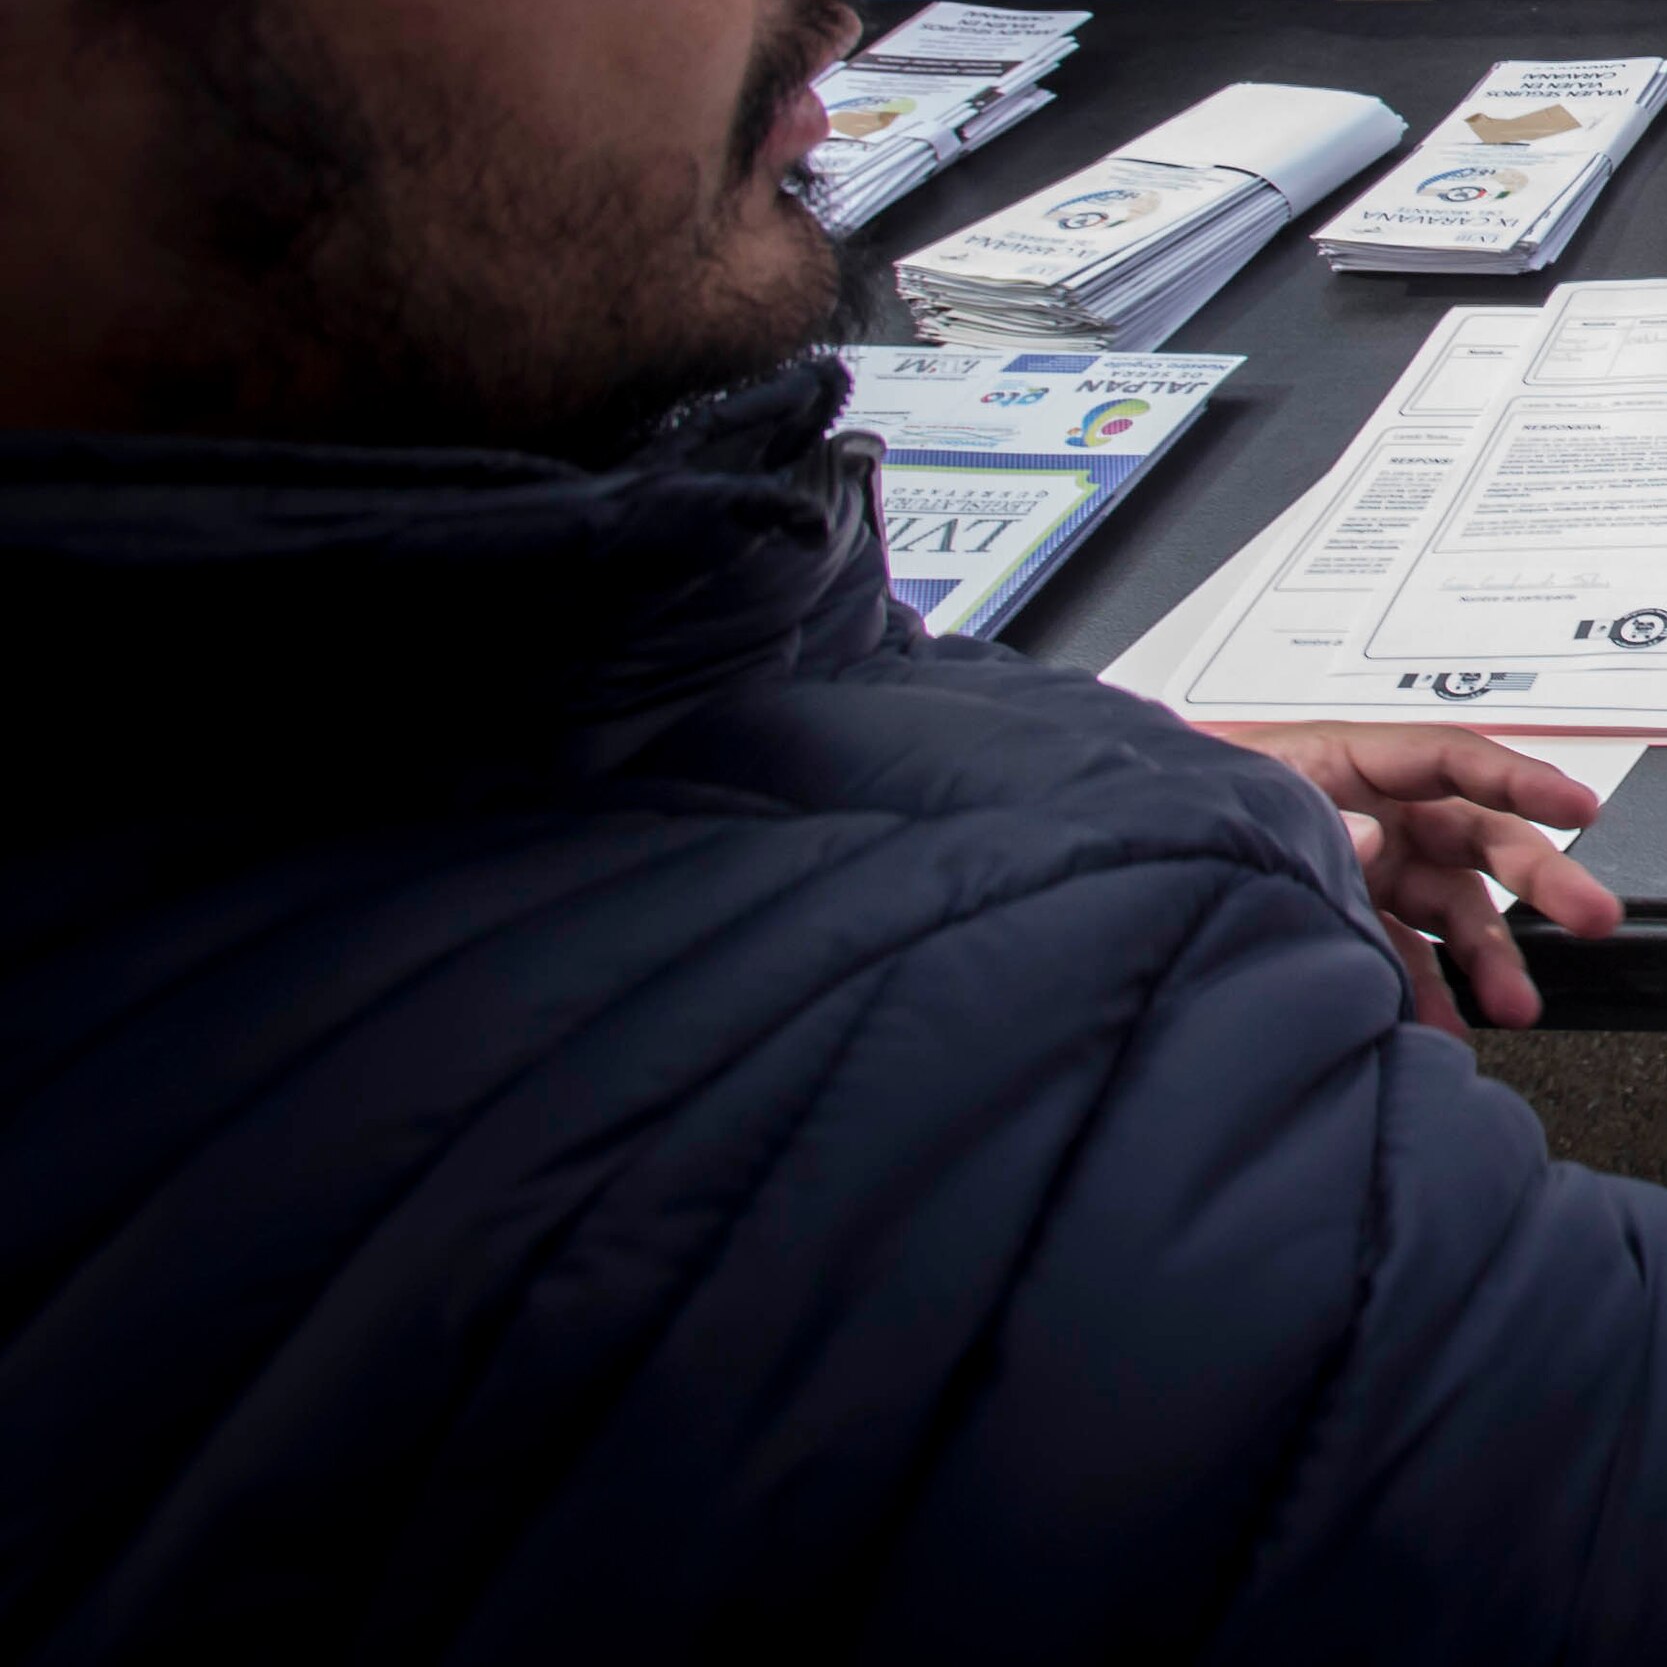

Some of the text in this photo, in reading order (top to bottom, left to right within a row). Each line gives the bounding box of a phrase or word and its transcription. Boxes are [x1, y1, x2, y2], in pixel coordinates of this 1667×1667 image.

[1486, 87, 1560, 97] SEGUROS
[1550, 81, 1603, 89] VIAJEN
[1363, 208, 1519, 230] IX CARAVANA
[980, 386, 1049, 406] gto
[1076, 379, 1208, 399] JALPAN
[883, 516, 1017, 553] LVI
